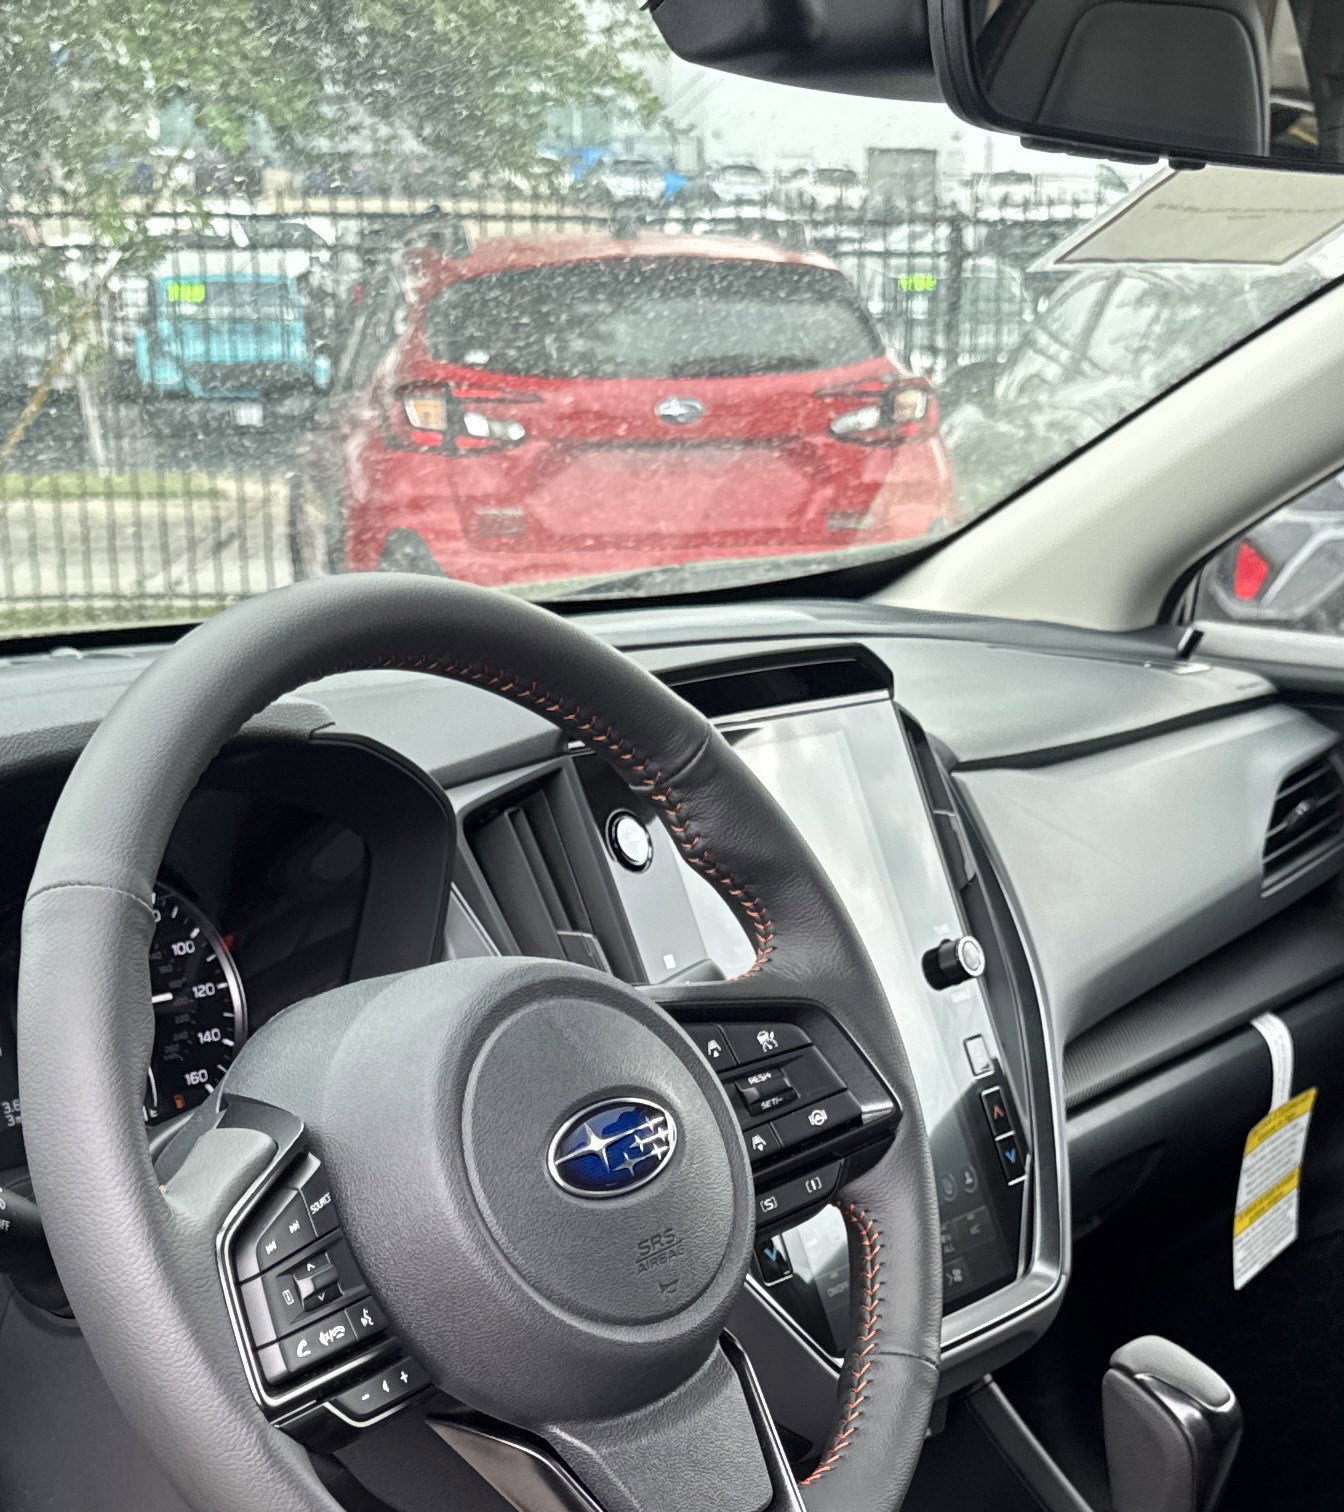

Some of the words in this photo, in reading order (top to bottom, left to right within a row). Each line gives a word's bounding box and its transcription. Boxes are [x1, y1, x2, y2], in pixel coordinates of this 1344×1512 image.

[171, 940, 196, 956] 100
[192, 982, 216, 998] 120
[197, 1028, 222, 1044] 140
[184, 1069, 208, 1086] 160
[309, 1192, 332, 1215] SOURCE
[637, 1227, 676, 1256] SRS
[637, 1244, 686, 1275] AIRBAG
